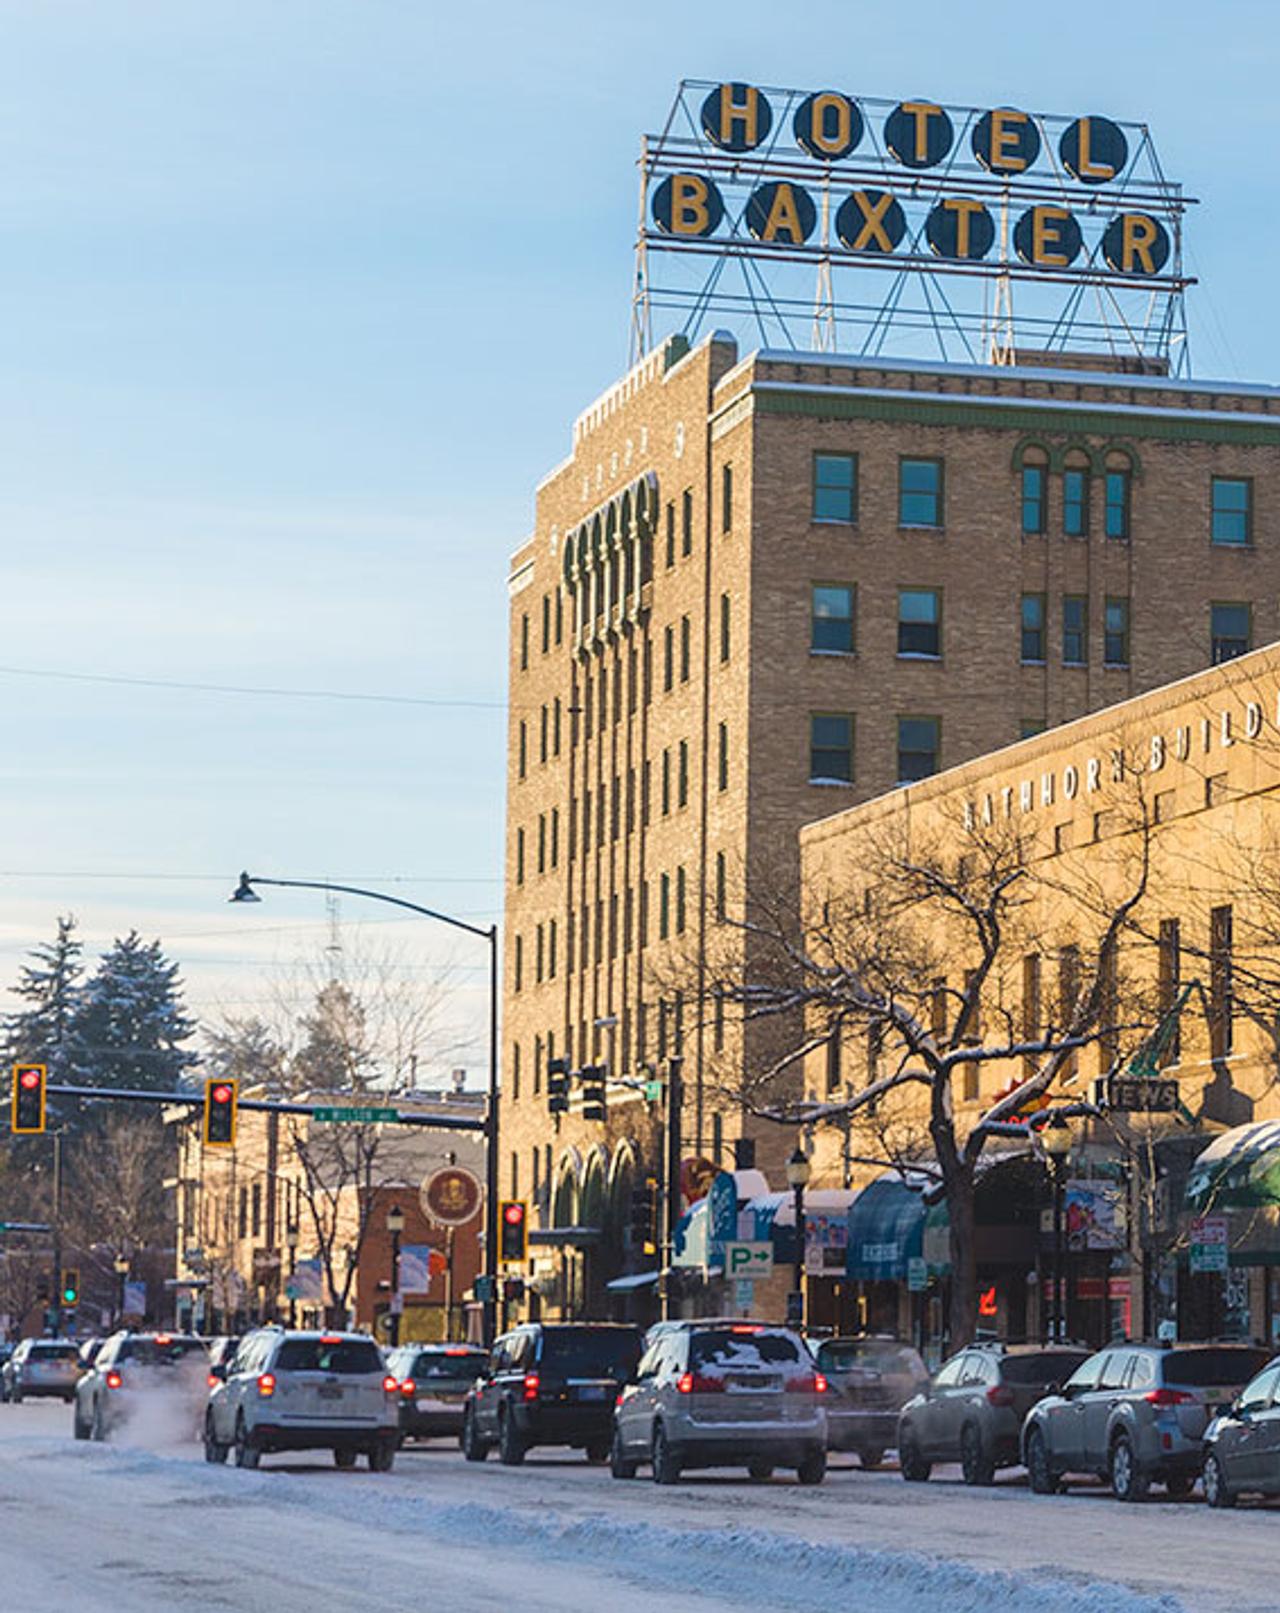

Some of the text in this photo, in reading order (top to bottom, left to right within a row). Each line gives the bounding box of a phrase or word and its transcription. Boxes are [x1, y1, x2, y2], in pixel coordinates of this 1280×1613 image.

[718, 83, 1115, 179] HOTEL
[670, 173, 1157, 275] BAXTER
[731, 1248, 751, 1273] P
